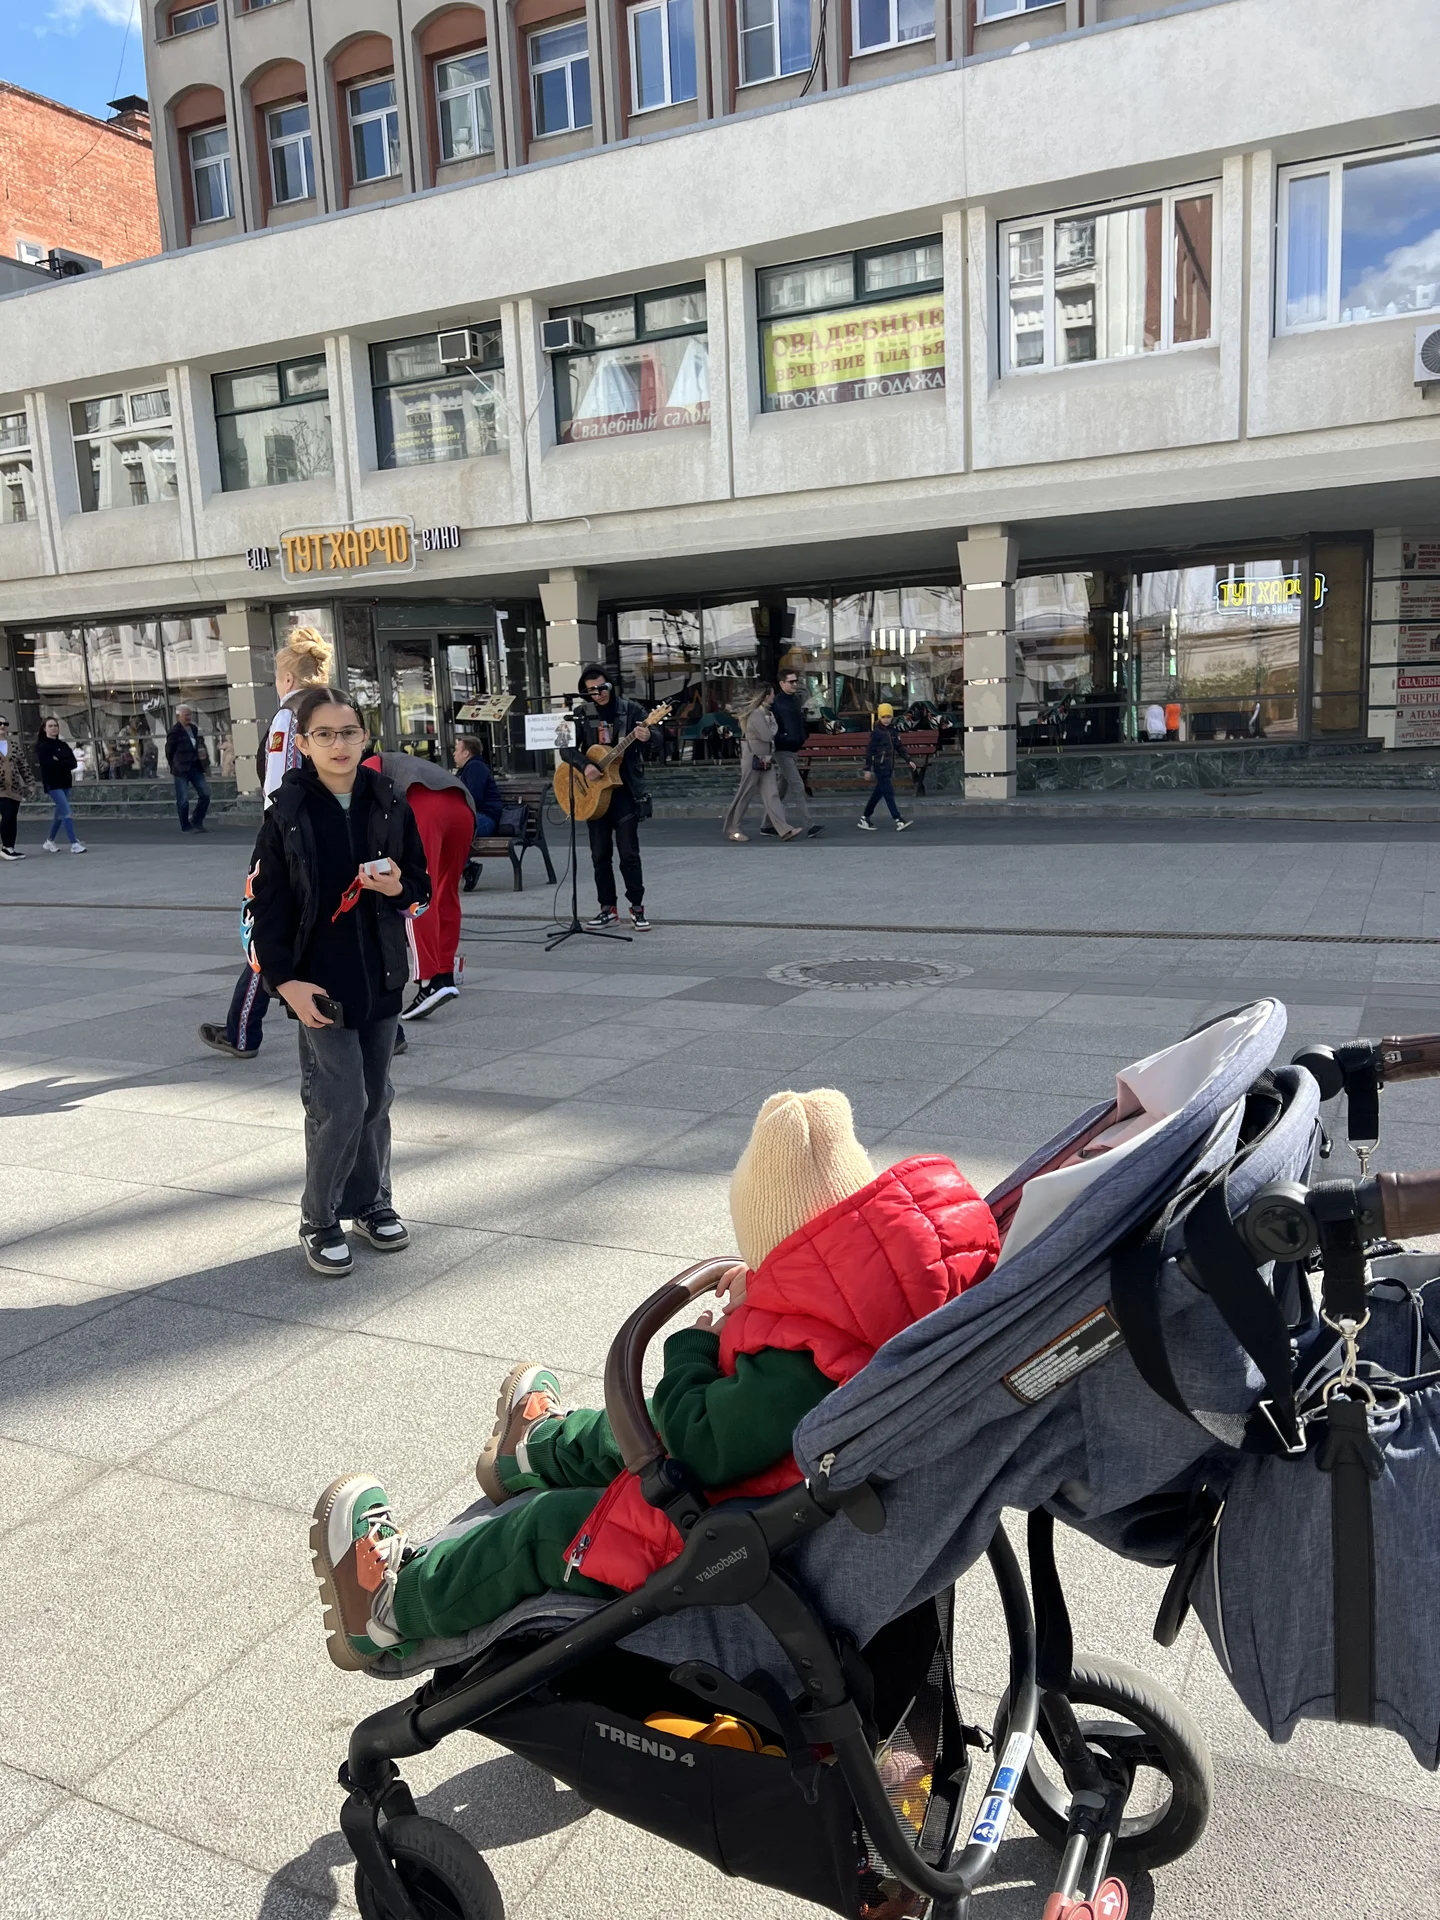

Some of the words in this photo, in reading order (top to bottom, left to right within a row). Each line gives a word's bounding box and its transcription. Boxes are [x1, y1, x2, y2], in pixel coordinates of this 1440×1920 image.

[773, 307, 944, 357] СВАДЕБНЫЕ
[776, 354, 865, 382] ВЕЧЕРНИЕ
[874, 341, 944, 365] ПЛАТЬЯ
[770, 387, 838, 410] ПРОКАТ
[855, 372, 944, 399] ПРОДАЖА
[571, 410, 657, 439] Свадебный
[663, 407, 710, 427] салон
[246, 547, 271, 570] ЕДА
[281, 533, 327, 573] ТУТ
[329, 524, 408, 569] ХАРЧО
[422, 525, 460, 550] ВИНО
[1220, 583, 1256, 607] ТУТ
[695, 1546, 748, 1583] valcobaby
[595, 1721, 676, 1762] TREND
[680, 1752, 696, 1767] 4
